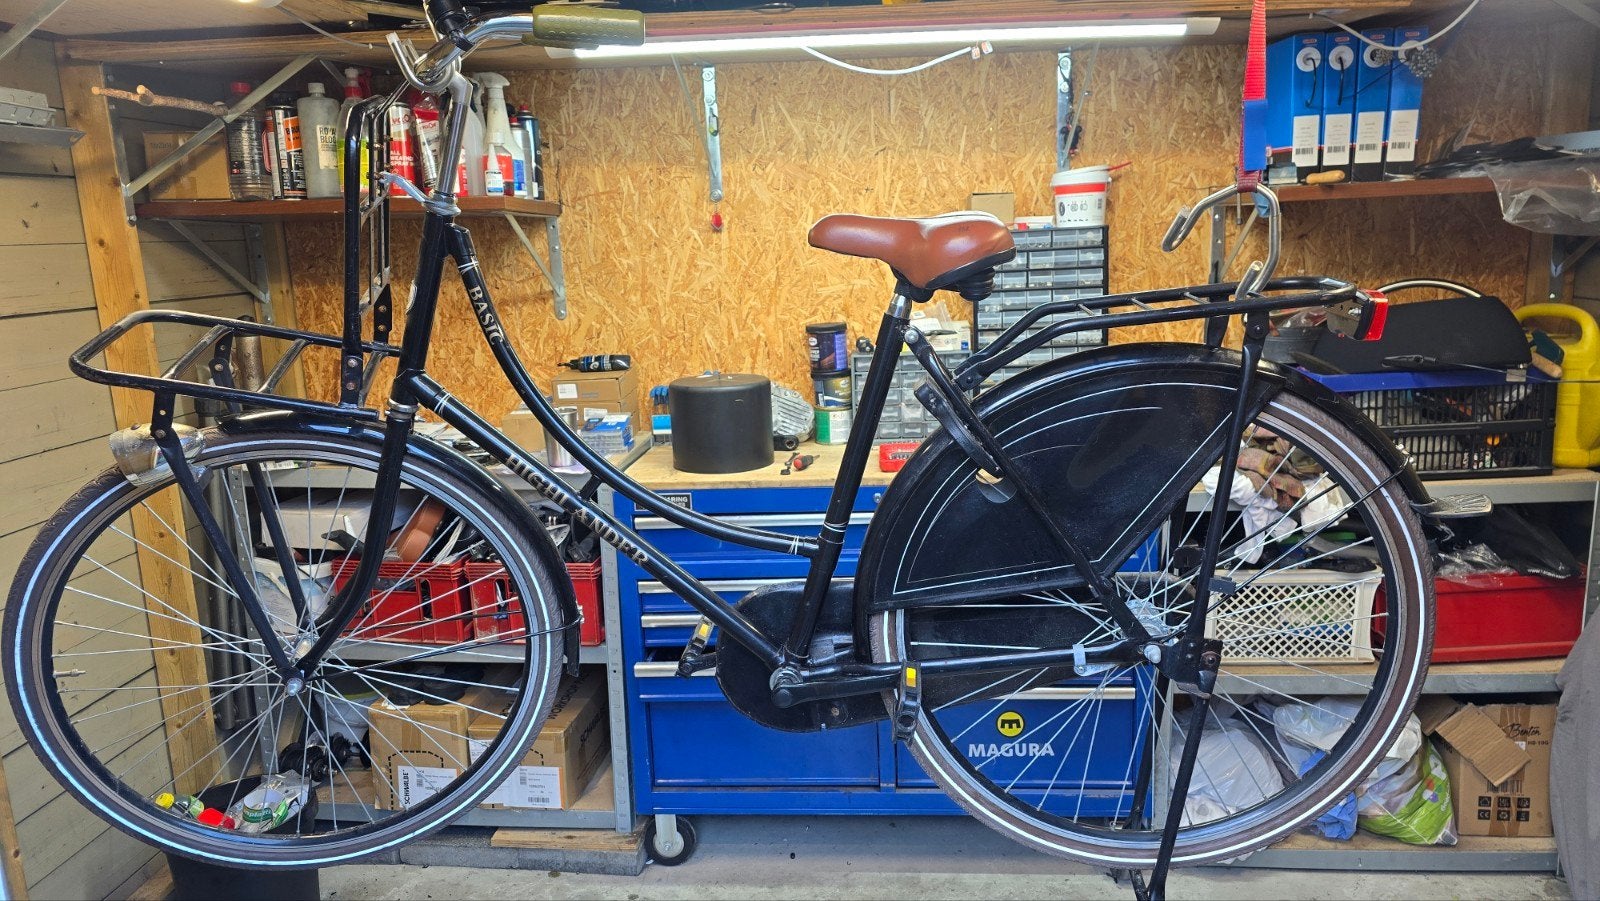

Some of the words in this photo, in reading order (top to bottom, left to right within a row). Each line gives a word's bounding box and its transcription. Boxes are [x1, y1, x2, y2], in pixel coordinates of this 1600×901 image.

[468, 284, 505, 346] BASIC
[968, 742, 1055, 758] MAGURA
[402, 771, 411, 805] SCHWALBE
